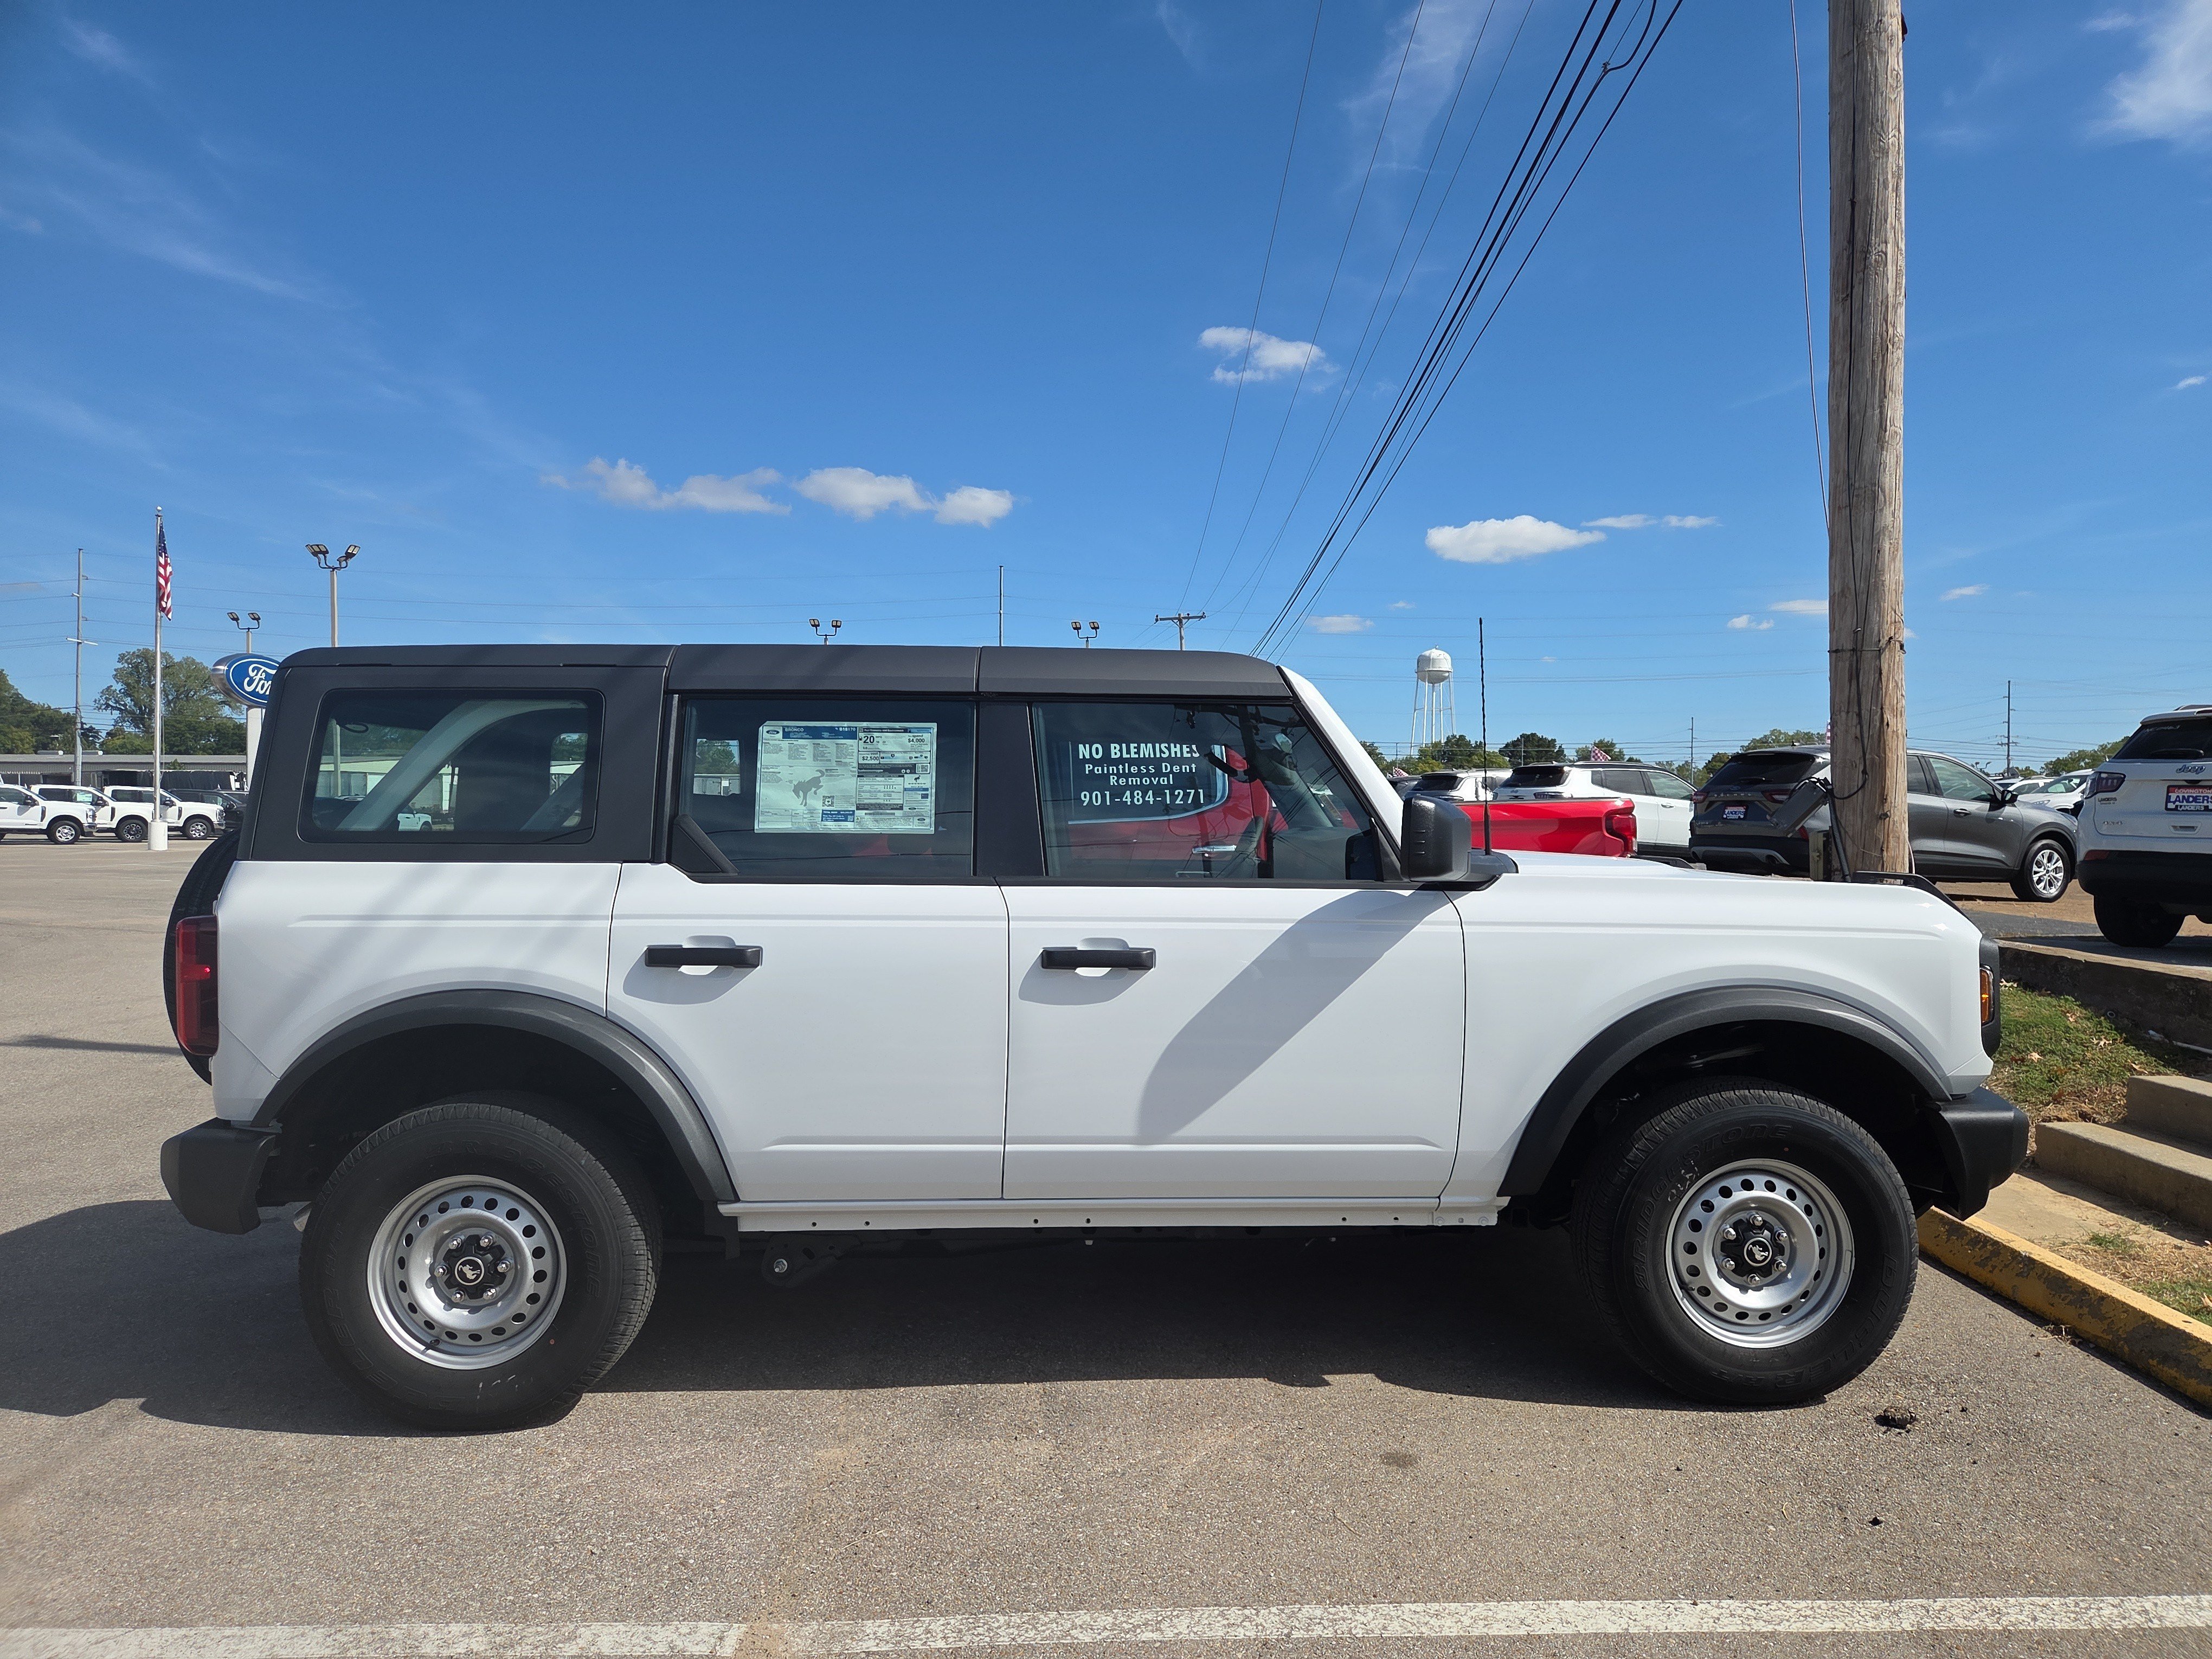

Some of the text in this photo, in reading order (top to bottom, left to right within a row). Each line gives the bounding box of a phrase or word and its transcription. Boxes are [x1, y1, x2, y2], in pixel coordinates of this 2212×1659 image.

[863, 735, 874, 743] 20
[1078, 743, 1200, 759] NO BLEMISHES
[1085, 762, 1197, 774] Paintless Dent
[2176, 764, 2206, 774] Jeep
[1110, 774, 1173, 786] Removal
[1081, 789, 1205, 806] 901-484-1271
